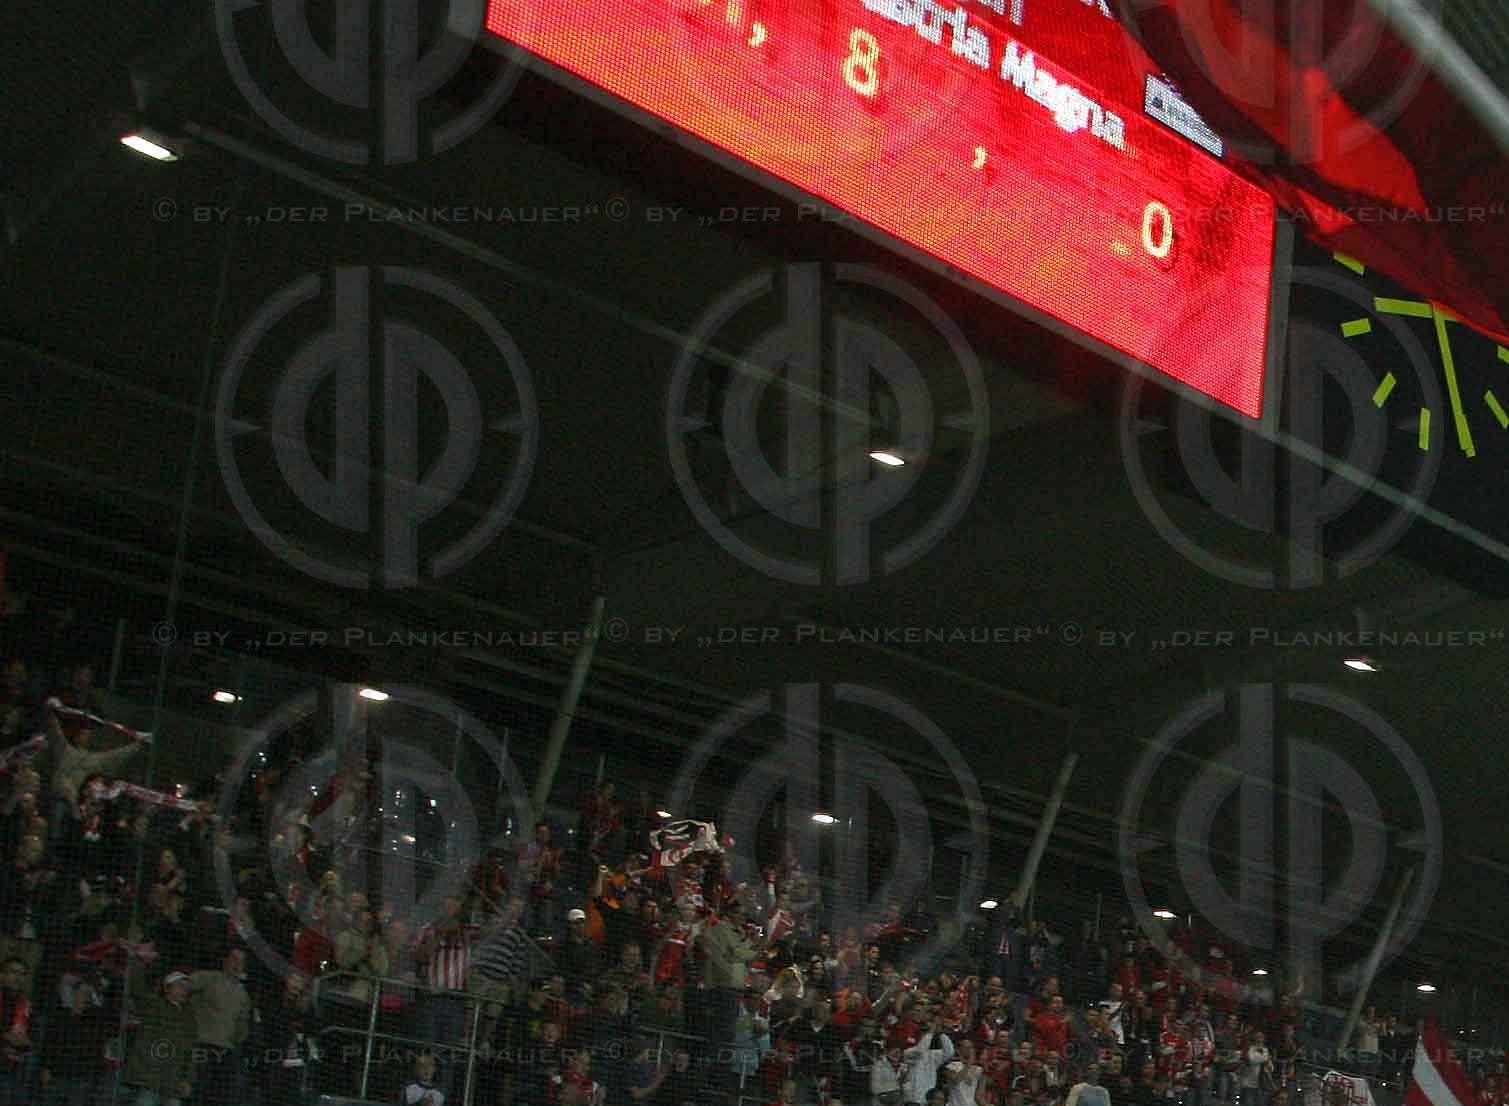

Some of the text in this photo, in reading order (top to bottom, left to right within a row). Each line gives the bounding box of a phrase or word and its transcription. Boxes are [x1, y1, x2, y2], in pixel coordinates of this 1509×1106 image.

[842, 28, 1173, 258] 8 0
[1000, 40, 1125, 150] Magna
